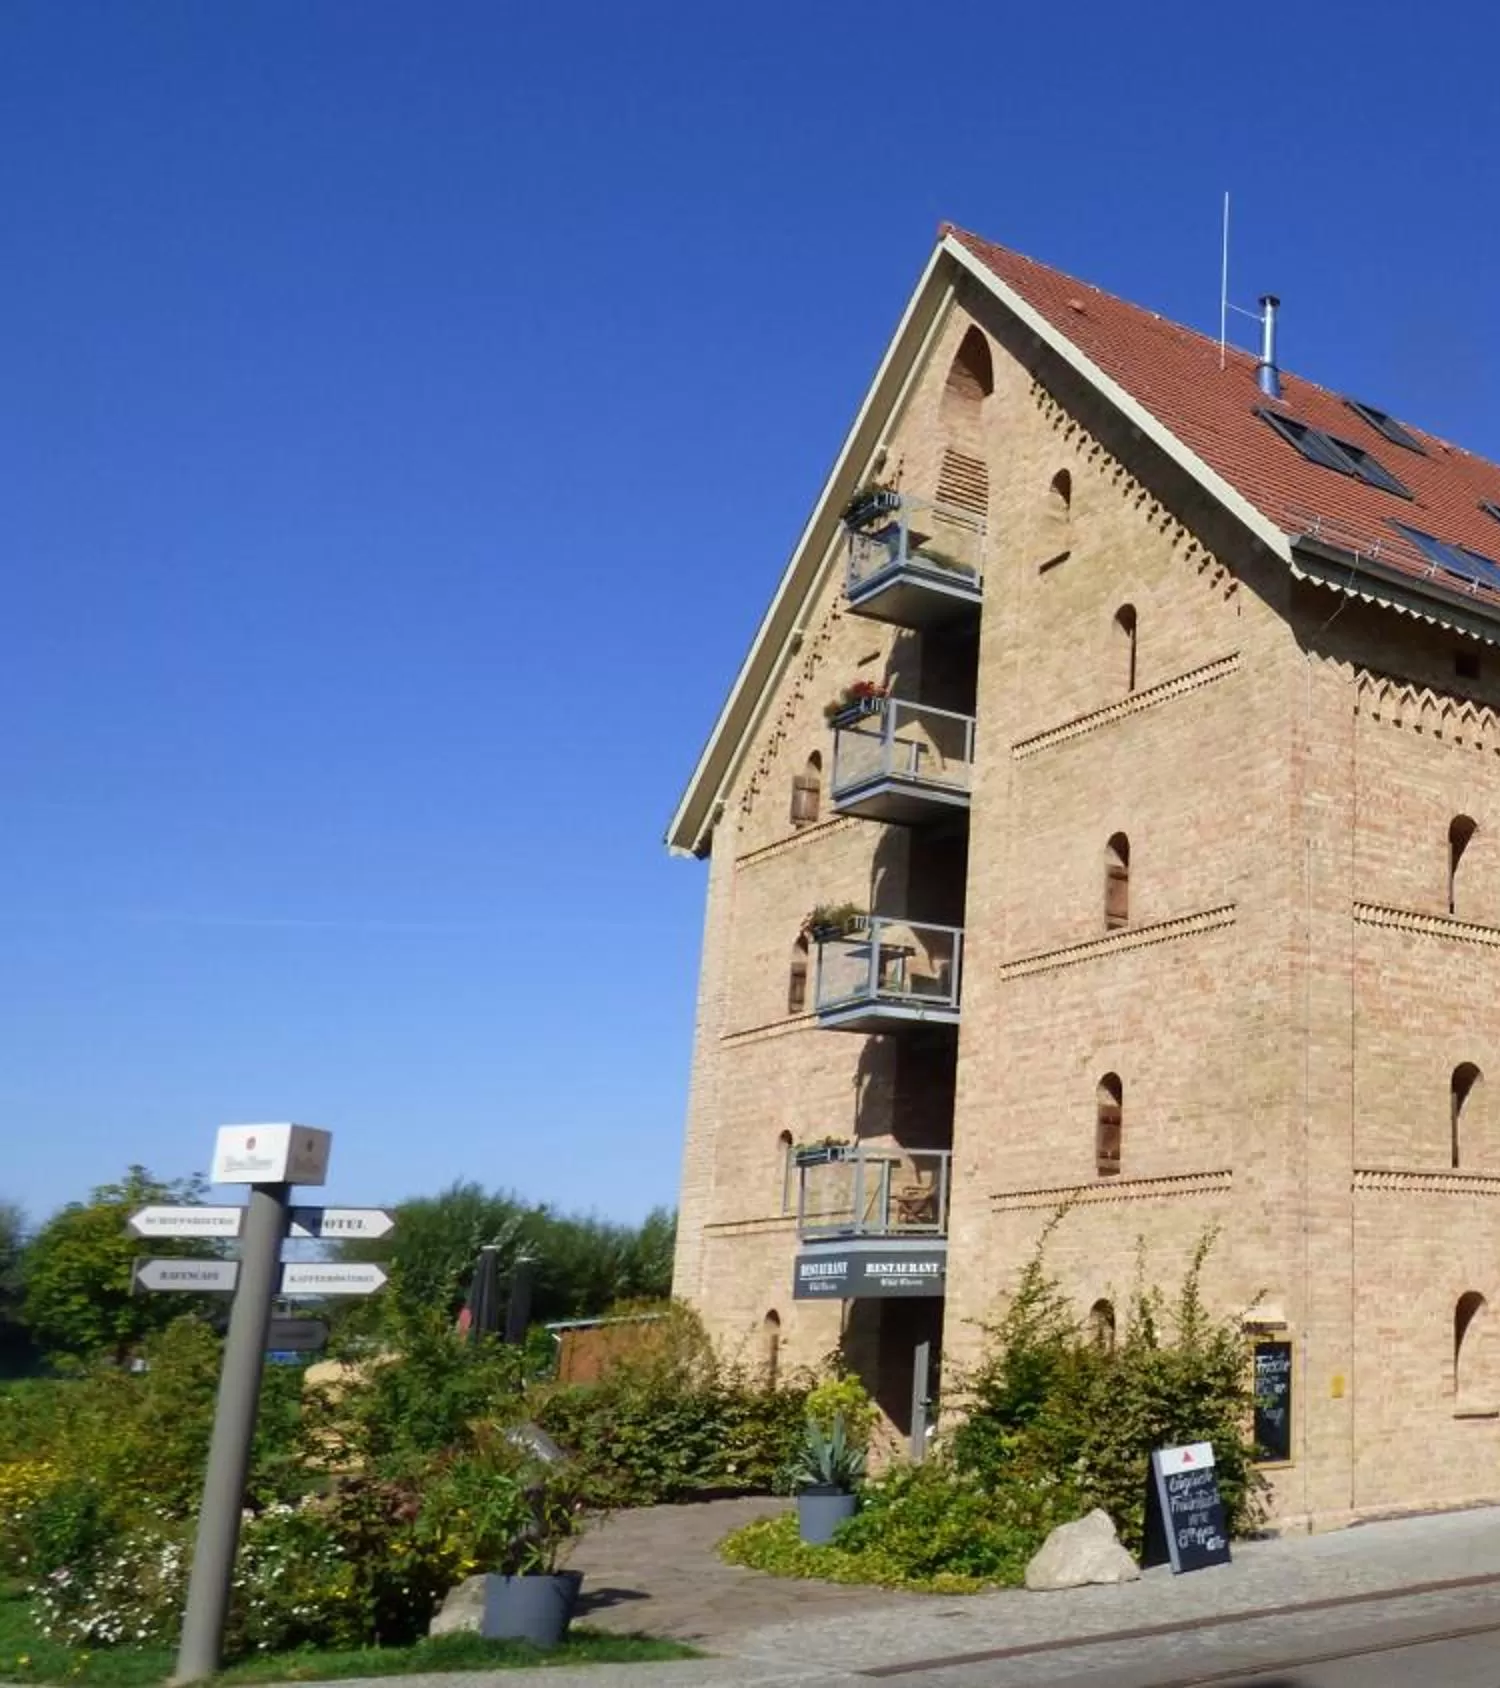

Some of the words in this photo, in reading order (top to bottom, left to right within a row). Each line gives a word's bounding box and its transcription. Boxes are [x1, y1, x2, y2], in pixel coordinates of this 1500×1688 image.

[312, 1217, 367, 1229] HOTEL
[801, 1261, 849, 1277] RESTAURANT
[865, 1262, 941, 1274] RESTAURANT
